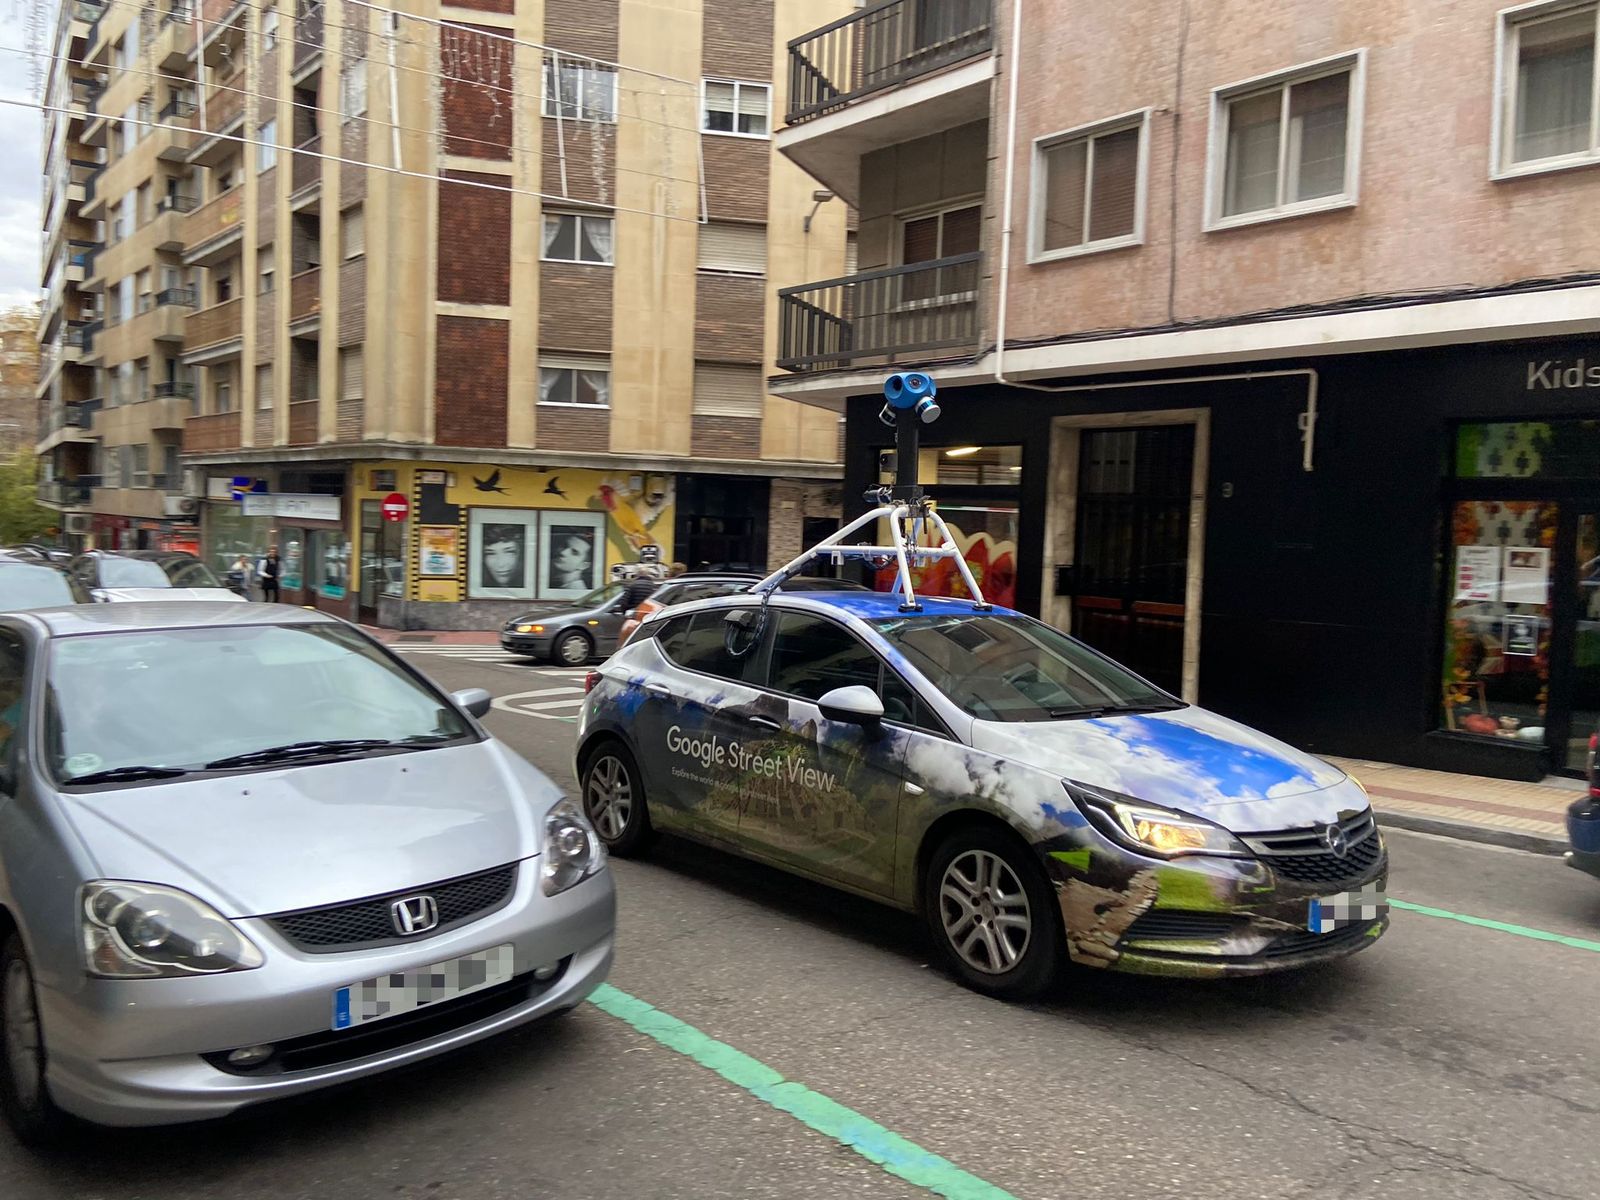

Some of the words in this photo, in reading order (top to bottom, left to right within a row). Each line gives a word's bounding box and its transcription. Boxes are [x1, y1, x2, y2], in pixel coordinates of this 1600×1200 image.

[1527, 358, 1600, 390] Kids
[666, 725, 725, 769] Google
[728, 741, 782, 780] Street
[787, 755, 835, 793] View
[671, 767, 689, 780] Explore
[690, 772, 699, 782] the
[699, 776, 714, 786] world
